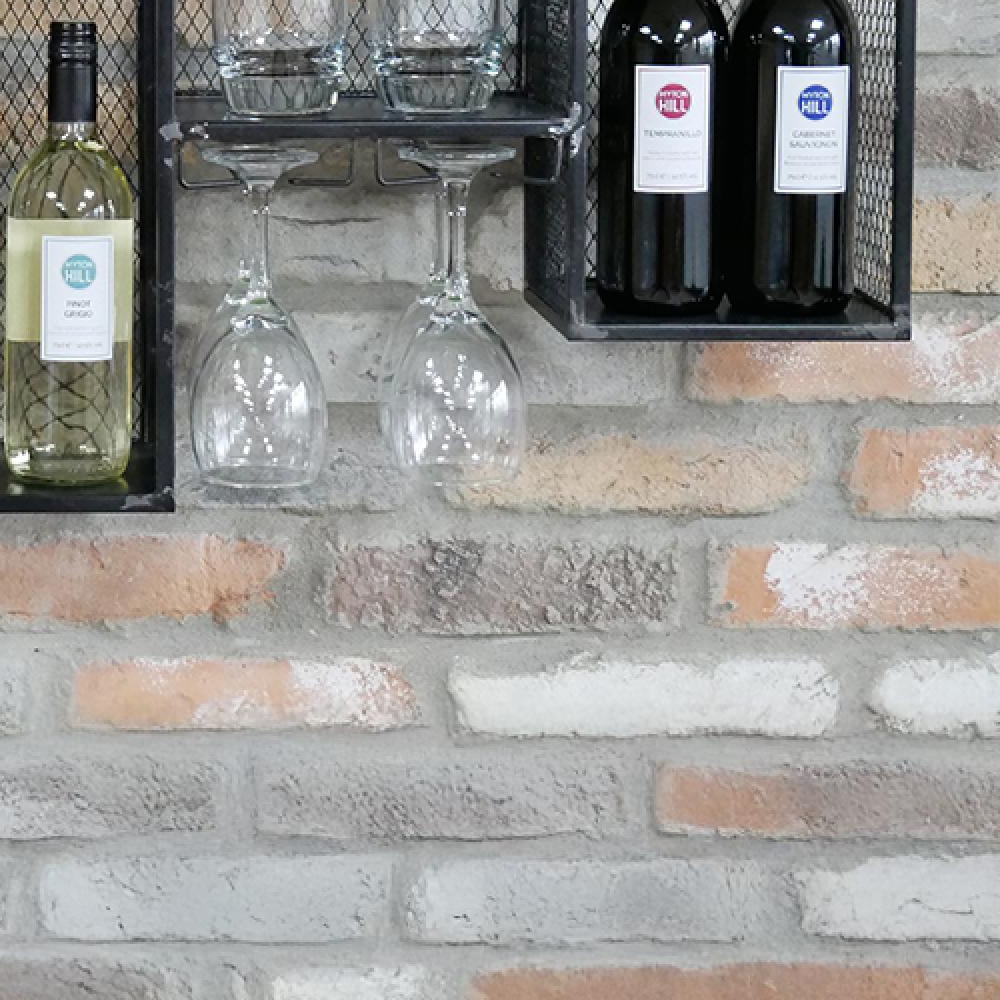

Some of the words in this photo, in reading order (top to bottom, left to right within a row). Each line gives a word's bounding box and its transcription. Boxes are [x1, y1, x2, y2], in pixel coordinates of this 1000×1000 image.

[660, 99, 687, 112] HILL
[801, 100, 829, 113] HILL
[792, 130, 836, 138] CABERNET
[65, 269, 92, 283] HILL
